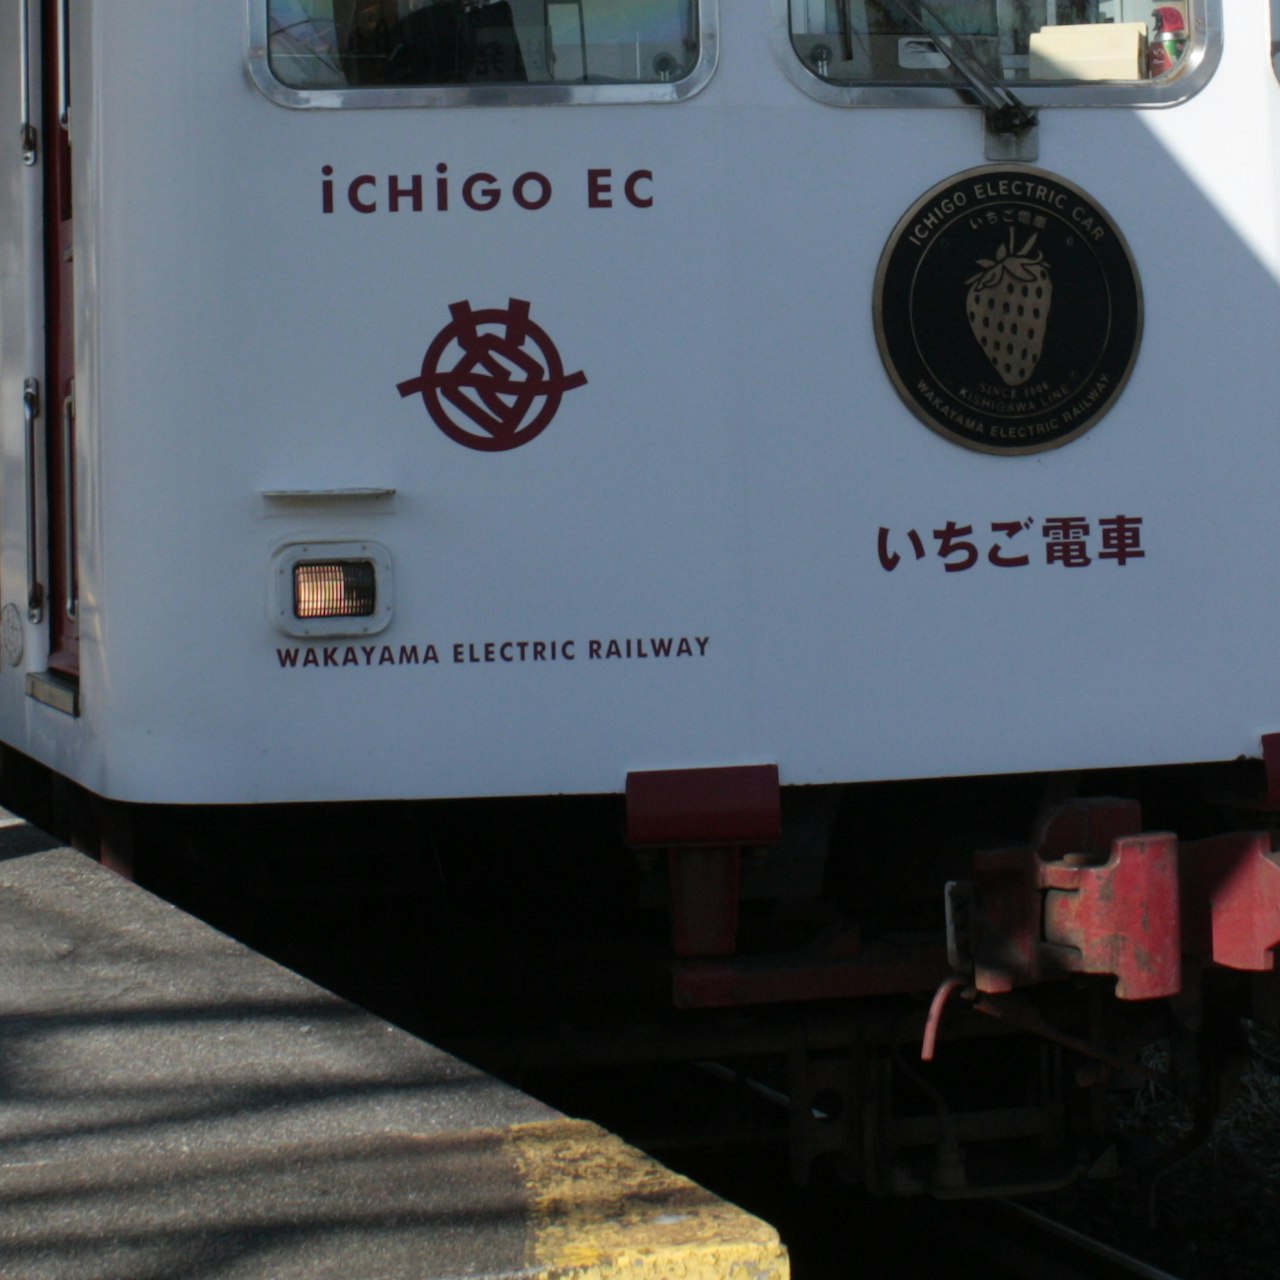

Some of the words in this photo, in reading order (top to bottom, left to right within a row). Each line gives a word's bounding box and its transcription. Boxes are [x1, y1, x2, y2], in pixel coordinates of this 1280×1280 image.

[586, 168, 654, 209] EC
[907, 190, 968, 247] ICHIGO
[973, 179, 1069, 210] ELECTRIC
[1071, 205, 1106, 242] CAR
[917, 378, 986, 435] WAKAYAMA
[989, 420, 1060, 439] ELECTRIC
[1063, 372, 1111, 427] RAILWAY
[958, 387, 1036, 413] KISHIGAWA
[1040, 384, 1071, 408] LINE
[877, 514, 1146, 573] いちご電車
[276, 644, 440, 669] WAKAYAMA
[452, 639, 577, 665] ELECTRIC
[587, 635, 712, 661] RAILWAY
